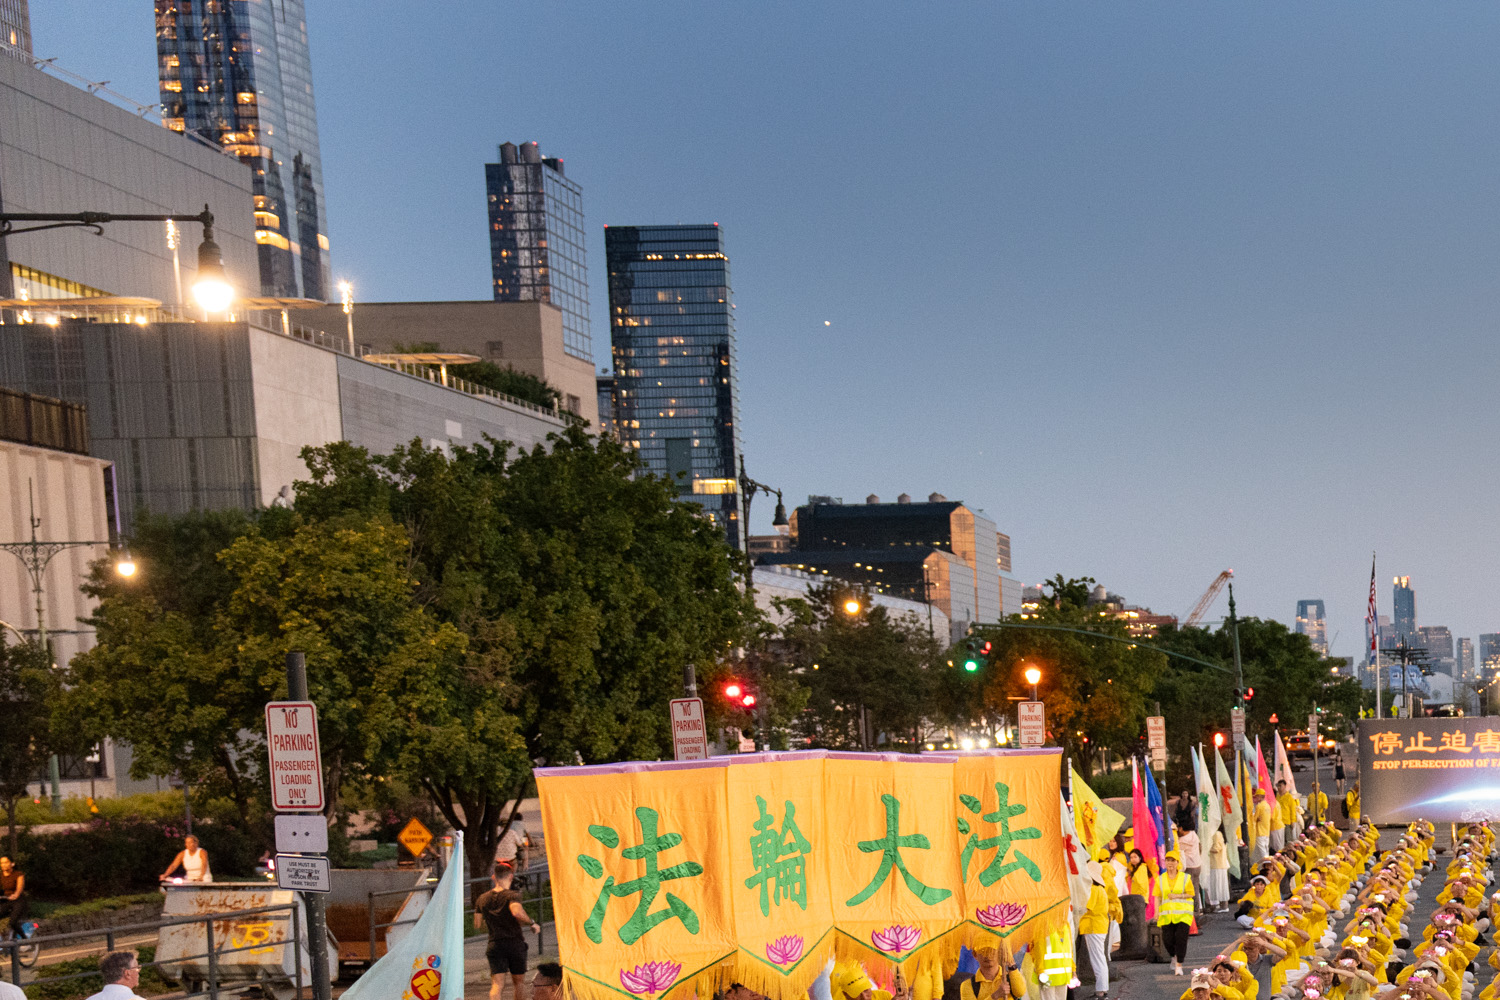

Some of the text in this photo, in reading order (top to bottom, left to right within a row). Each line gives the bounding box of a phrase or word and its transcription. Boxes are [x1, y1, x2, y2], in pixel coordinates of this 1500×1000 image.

[682, 703, 691, 716] NO
[285, 711, 298, 728] NO
[676, 719, 702, 732] PARKING
[273, 734, 313, 751] PARKING
[677, 736, 704, 745] PASSENGER
[681, 746, 702, 754] LOADING
[275, 760, 316, 771] PASSENGER
[1372, 761, 1400, 770] STOP
[1402, 759, 1474, 769] PERSECUTION
[1475, 758, 1490, 768] OF
[281, 775, 312, 785] LOADING
[289, 788, 307, 799] ONLY
